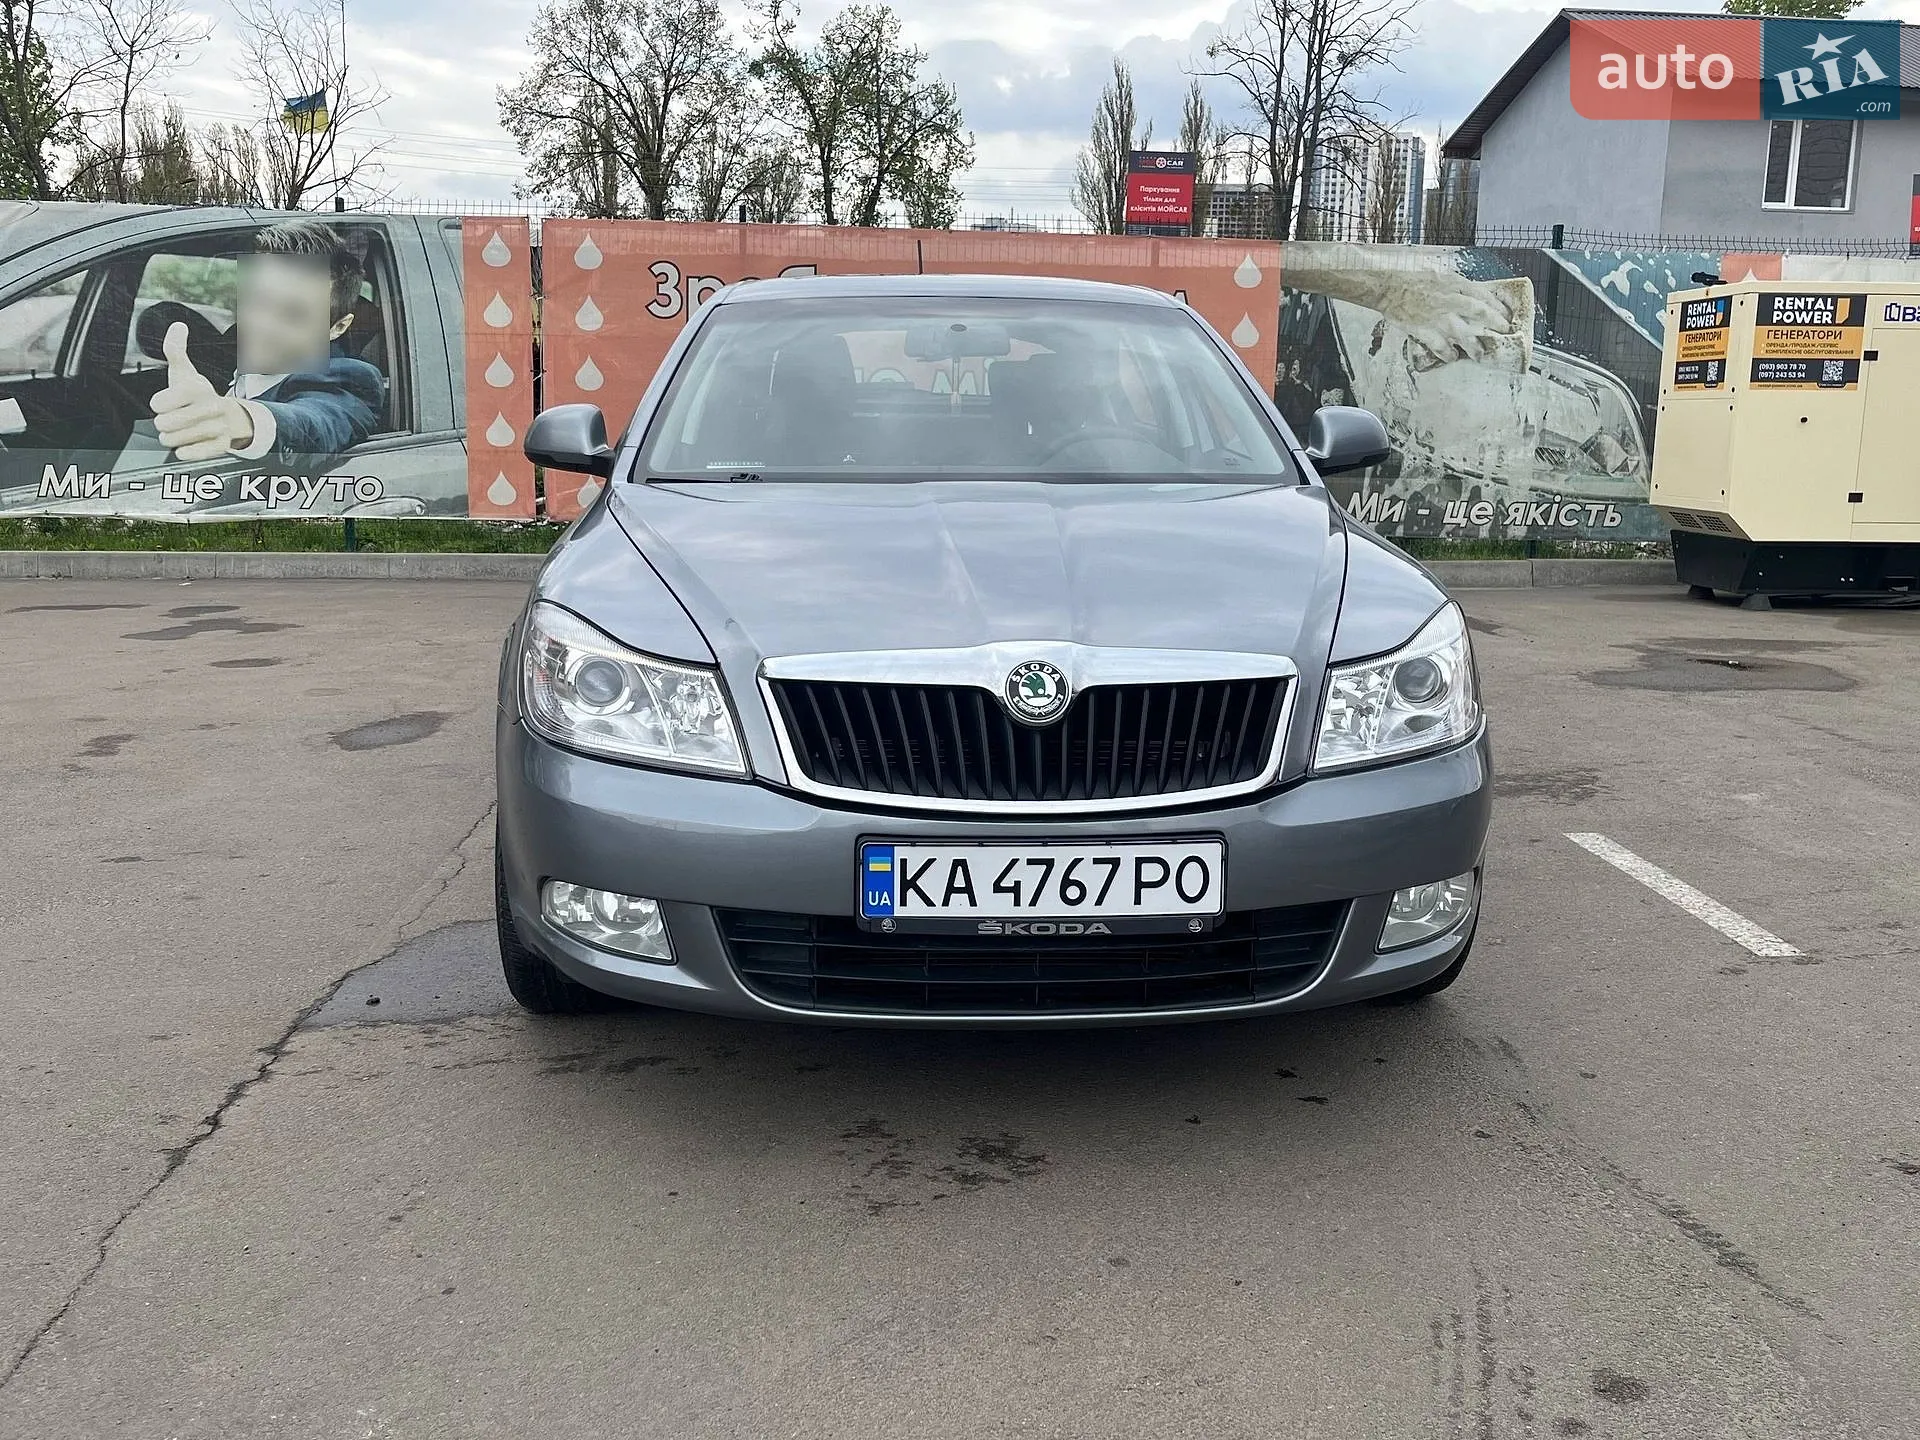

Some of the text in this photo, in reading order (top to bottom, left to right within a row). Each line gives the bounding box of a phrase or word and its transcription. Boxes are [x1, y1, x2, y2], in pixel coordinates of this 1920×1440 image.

[1686, 300, 1717, 317] RENTAL
[1773, 296, 1834, 310] RENTAL
[1685, 314, 1715, 329] POWER
[1772, 311, 1833, 324] POWER
[1684, 330, 1722, 344] ГЕНЕРАТОРИ
[1766, 329, 1843, 341] ГЕНЕРАТОРИ
[37, 463, 385, 510] Ми - це круто
[1347, 491, 1623, 528] Ми - це якість
[899, 855, 1211, 908] KA 4767 PO
[868, 891, 892, 907] UA
[977, 920, 1113, 936] ŠKODA
